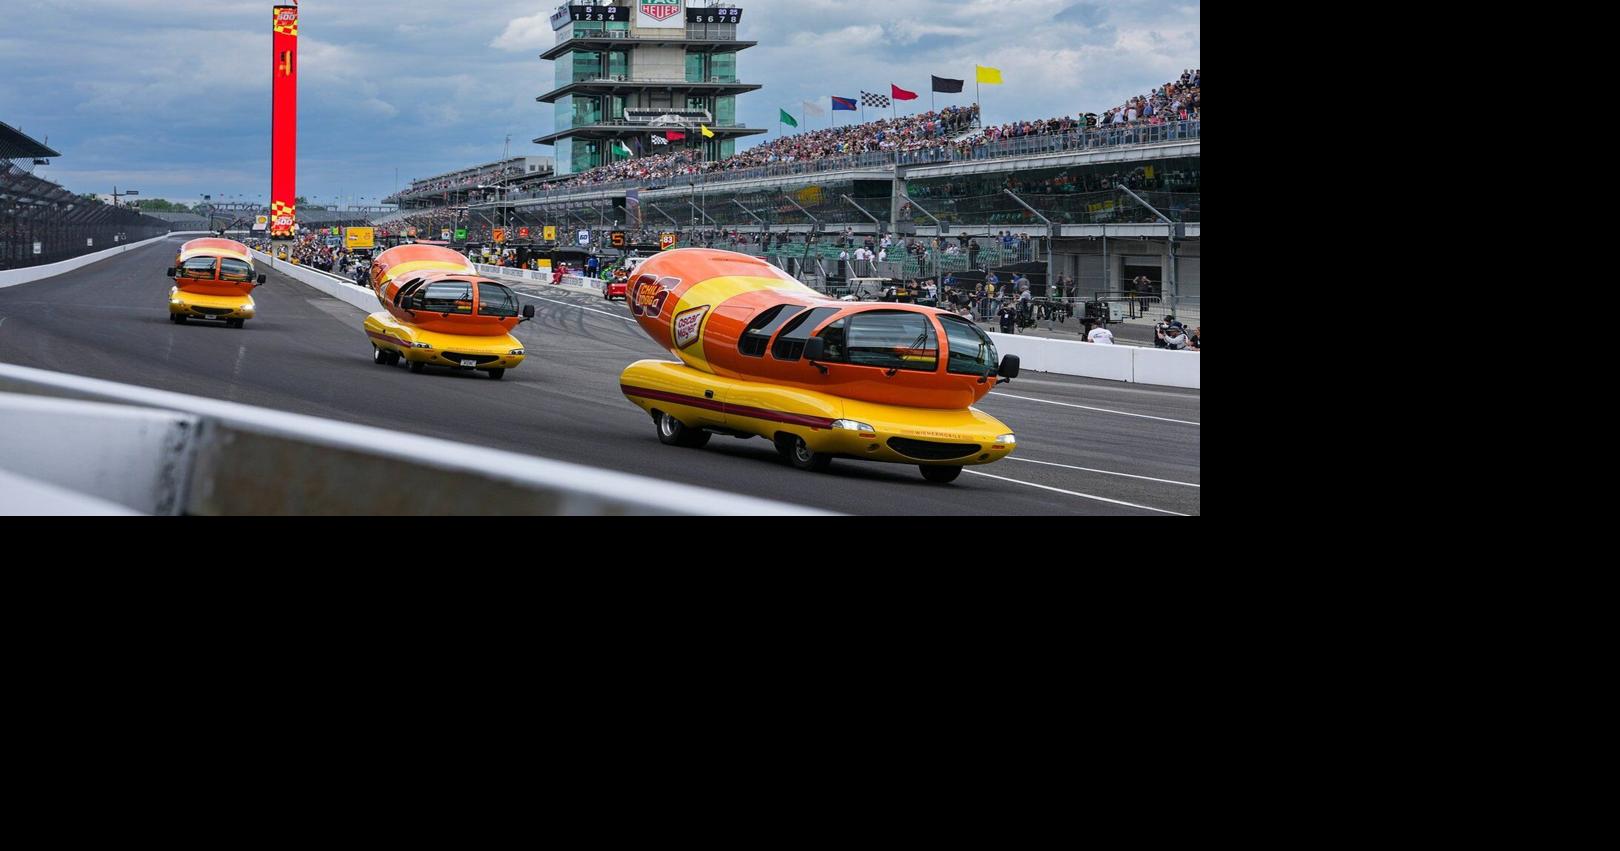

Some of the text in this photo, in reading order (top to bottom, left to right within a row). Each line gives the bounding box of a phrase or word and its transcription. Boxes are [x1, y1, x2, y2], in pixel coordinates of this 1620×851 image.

[278, 13, 295, 21] 500
[643, 6, 678, 18] HEUER
[275, 218, 293, 226] 500
[494, 230, 502, 240] 7
[611, 234, 624, 246] 5
